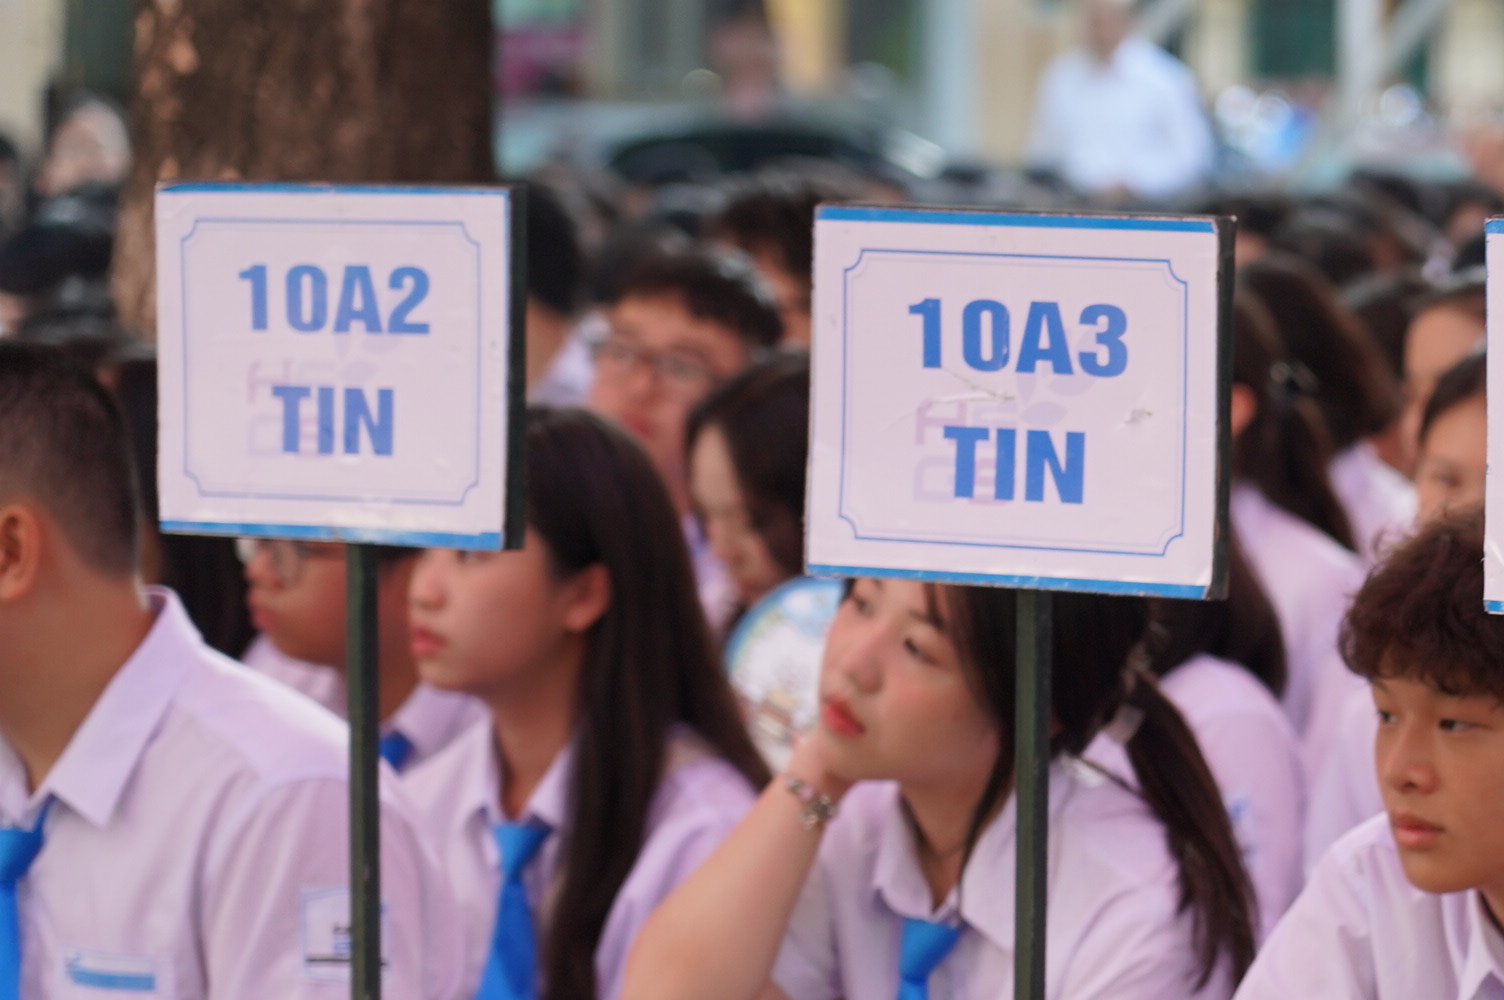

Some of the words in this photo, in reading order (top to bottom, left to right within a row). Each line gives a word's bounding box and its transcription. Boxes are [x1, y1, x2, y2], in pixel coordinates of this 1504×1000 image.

[239, 264, 430, 335] 10A2
[908, 297, 1128, 378] 10A3
[272, 385, 394, 456] TIN
[943, 425, 1086, 505] TIN
